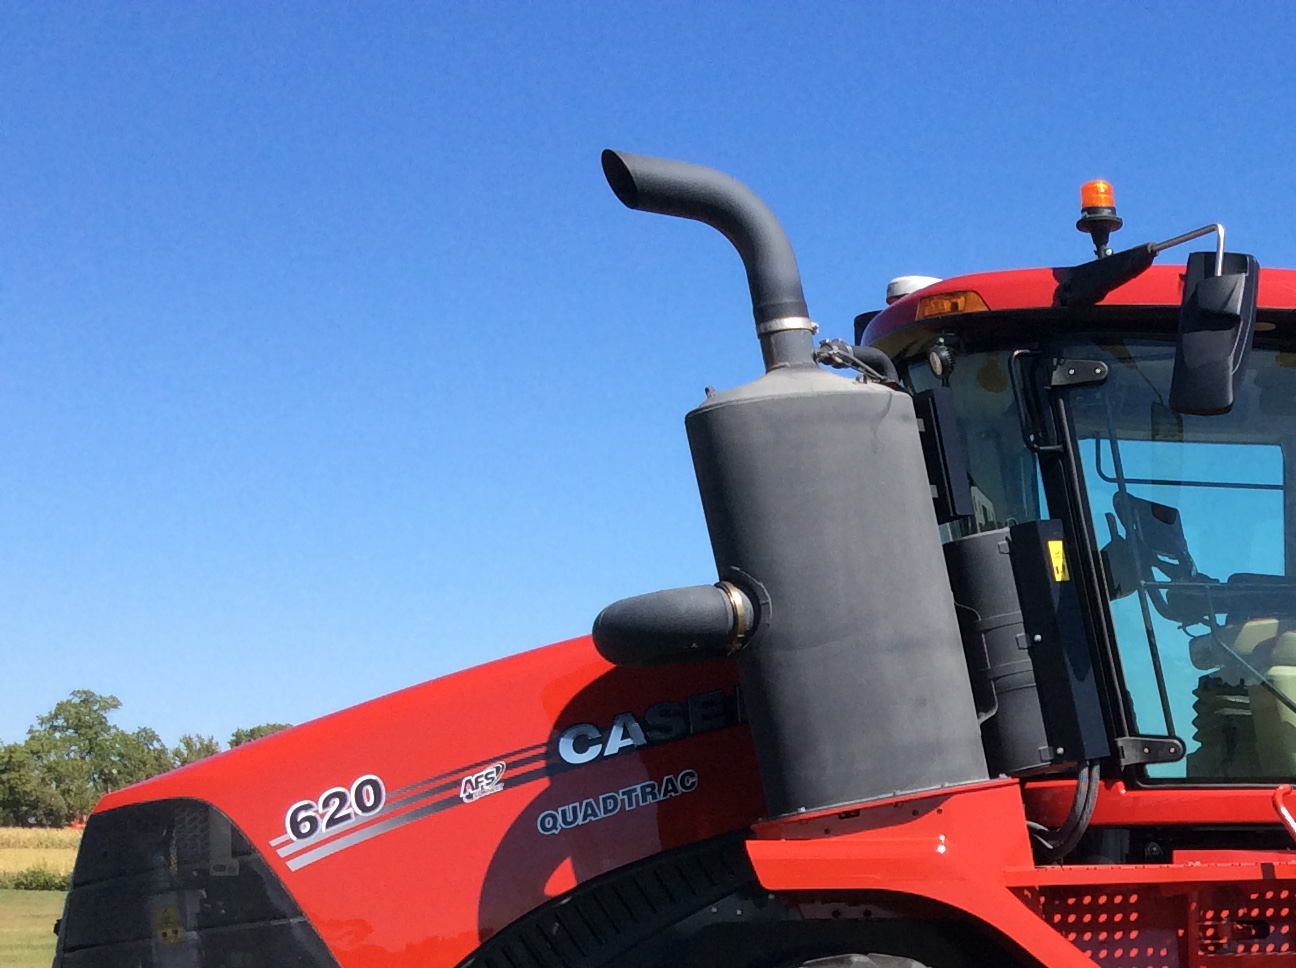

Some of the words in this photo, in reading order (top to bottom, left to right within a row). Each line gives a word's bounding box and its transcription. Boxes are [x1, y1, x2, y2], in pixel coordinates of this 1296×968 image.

[558, 688, 727, 765] CASE
[285, 774, 386, 841] 620
[461, 768, 497, 795] AFS
[537, 769, 698, 835] QUADTRAC
